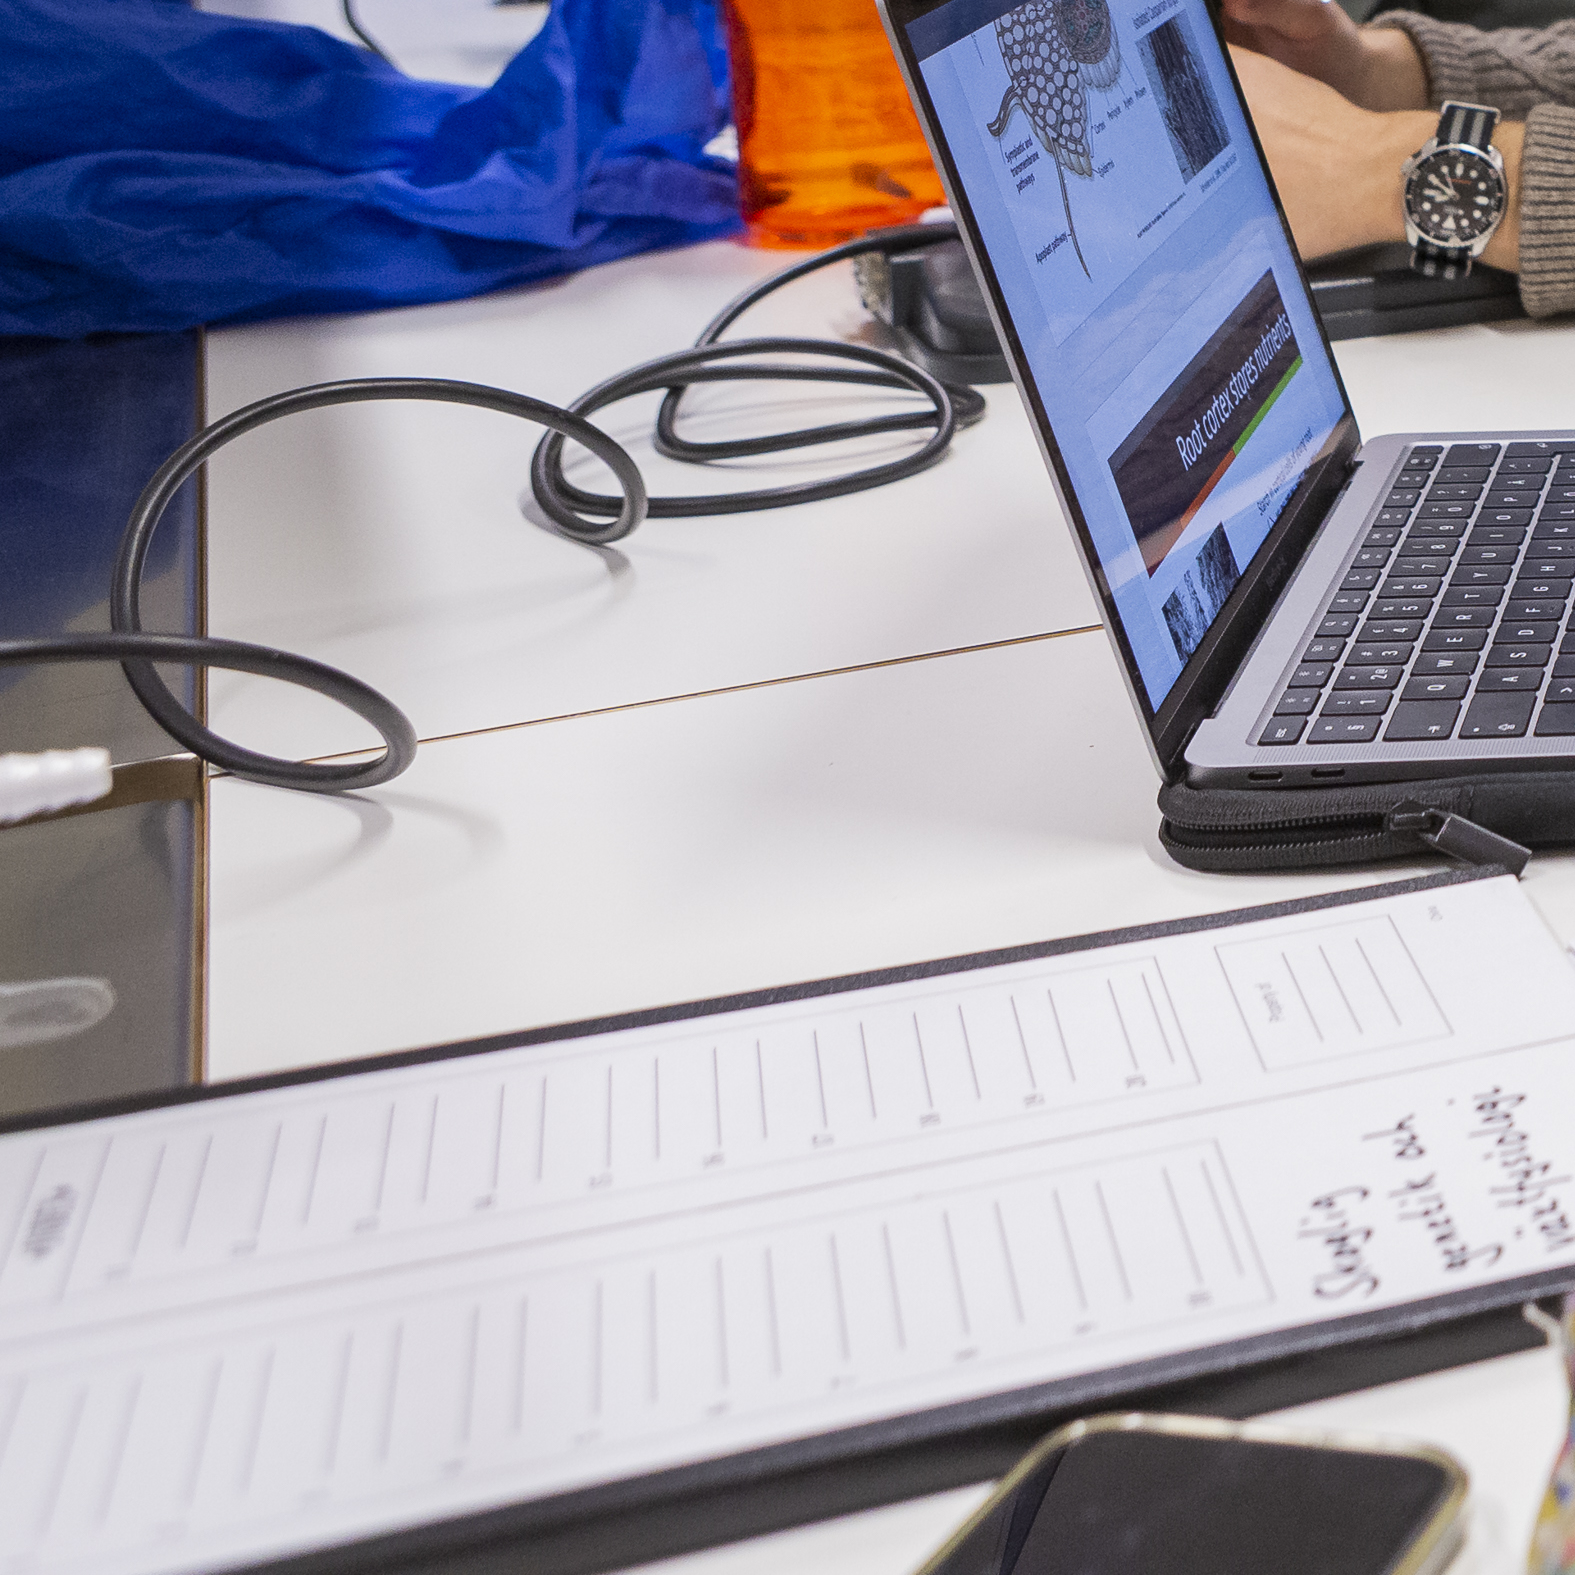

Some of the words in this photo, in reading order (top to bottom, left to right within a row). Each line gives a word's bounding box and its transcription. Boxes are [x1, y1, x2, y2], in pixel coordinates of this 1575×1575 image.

[1175, 419, 1207, 471] Root
[1202, 387, 1235, 441] cortex
[1229, 354, 1259, 406] stores
[1253, 313, 1292, 373] nutrients
[1436, 659, 1455, 668] W
[1501, 675, 1519, 683] A
[1360, 1111, 1427, 1161] och
[1387, 1170, 1505, 1273] genetik
